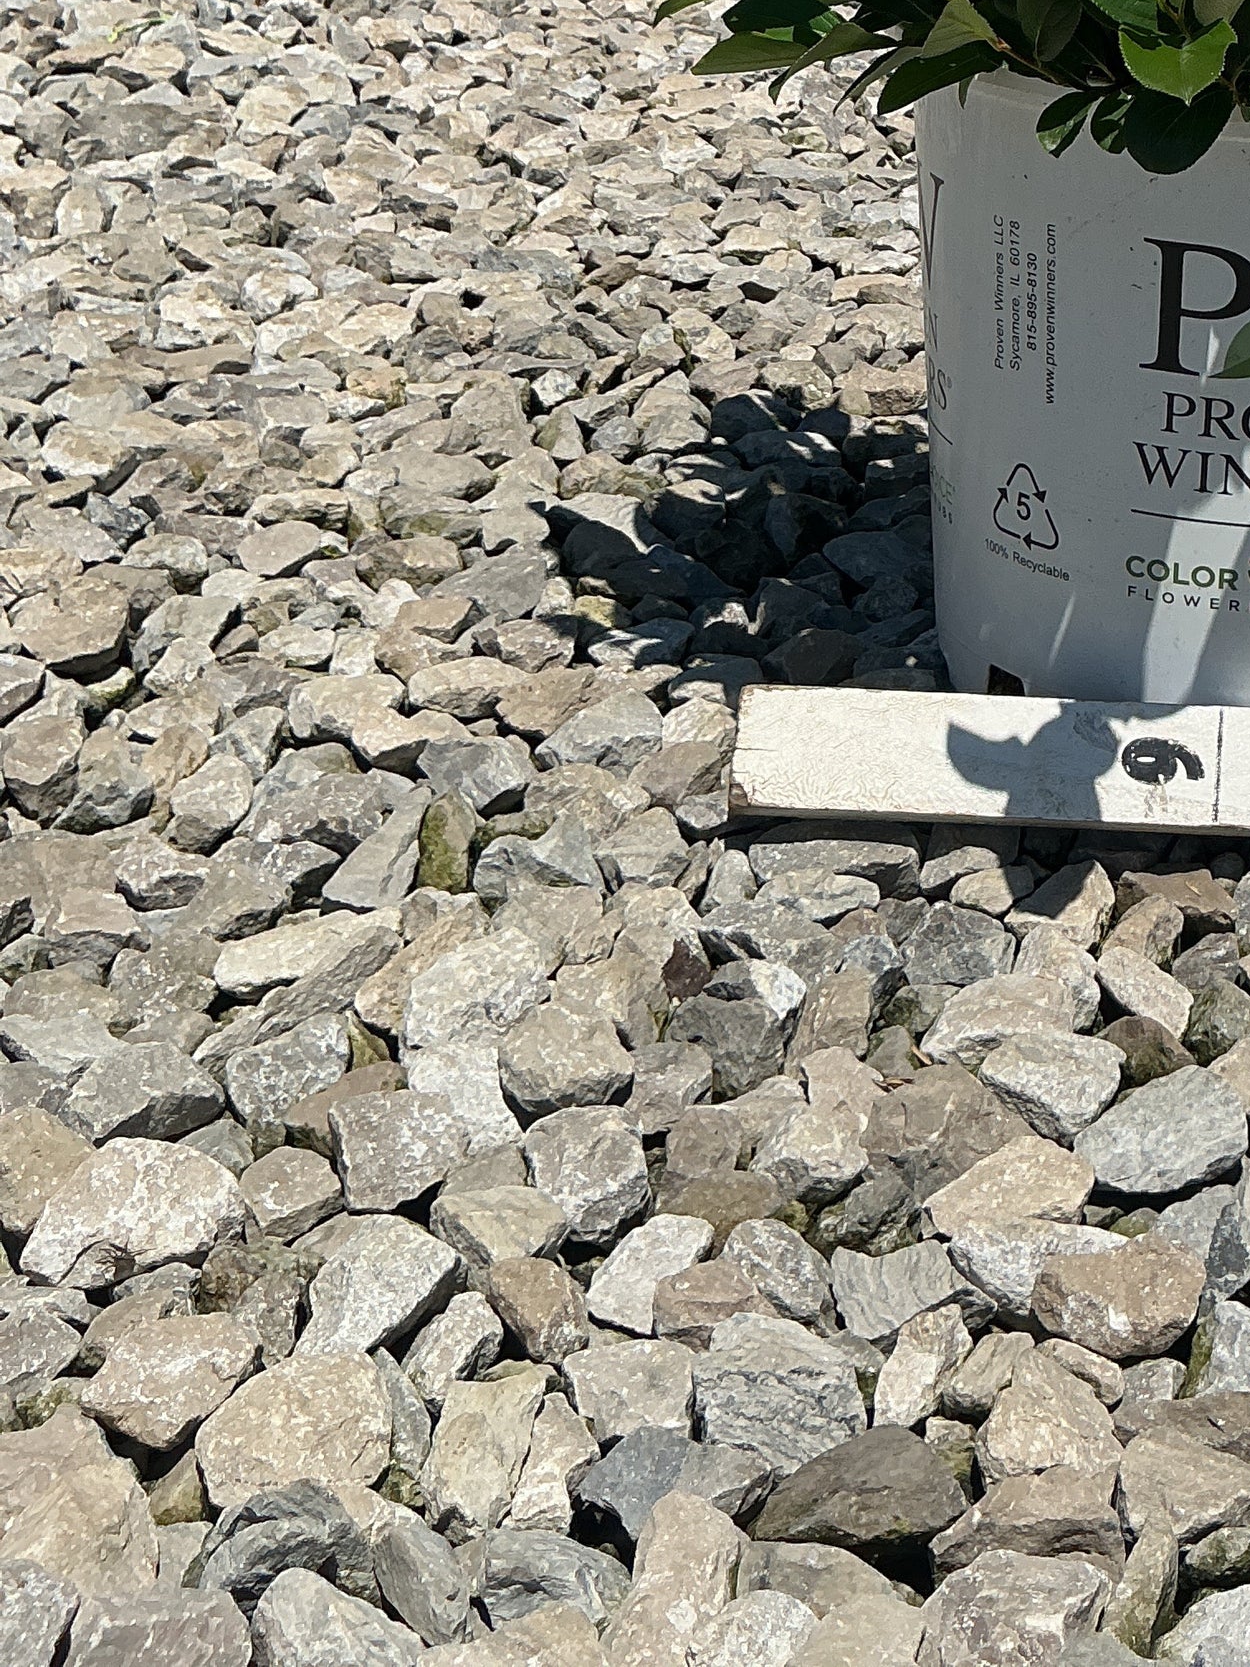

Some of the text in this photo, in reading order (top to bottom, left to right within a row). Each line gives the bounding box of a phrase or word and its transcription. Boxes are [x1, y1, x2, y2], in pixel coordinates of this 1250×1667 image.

[1009, 220, 1020, 266] 60178
[993, 214, 1004, 370] Proven Winners LLC
[1010, 273, 1020, 287] IL
[1026, 252, 1037, 351] 815-895-8130
[1046, 223, 1057, 404] www.provenwinners.com
[1016, 491, 1031, 521] 5
[984, 537, 1071, 582] 100% Recyclable
[1125, 555, 1239, 591] COLOR
